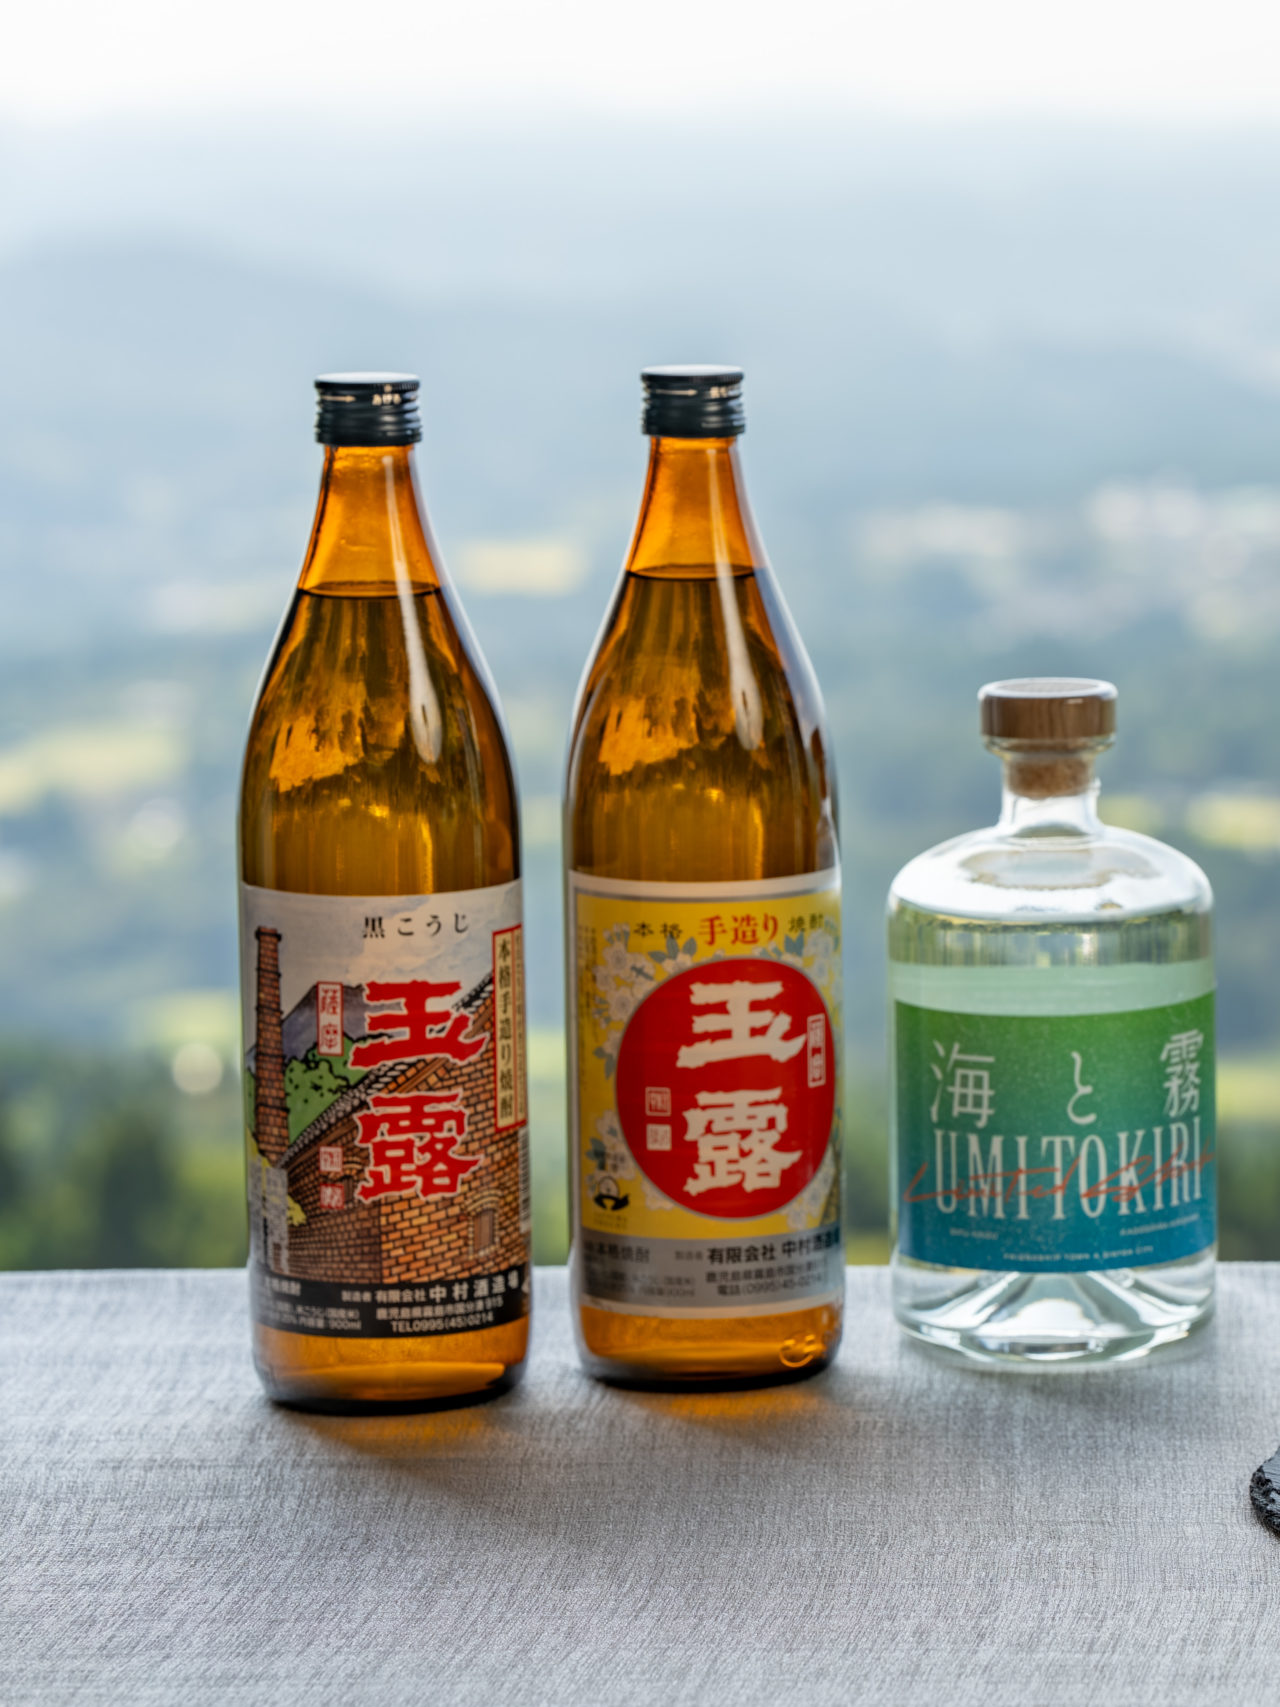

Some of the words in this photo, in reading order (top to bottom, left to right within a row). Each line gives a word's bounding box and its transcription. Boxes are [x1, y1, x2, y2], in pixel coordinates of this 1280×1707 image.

[362, 912, 470, 939] 黒こうじ
[632, 921, 682, 941] 本格
[698, 913, 779, 946] 手造り
[349, 980, 489, 1204] 玉露
[676, 980, 807, 1196] 玉露
[930, 1028, 1205, 1129] 海と霧
[933, 1115, 1203, 1221] UMITOKIRI
[375, 1288, 427, 1304] 有限会社
[429, 1269, 520, 1304] 中村酒造場
[707, 1242, 777, 1265] 有限会社
